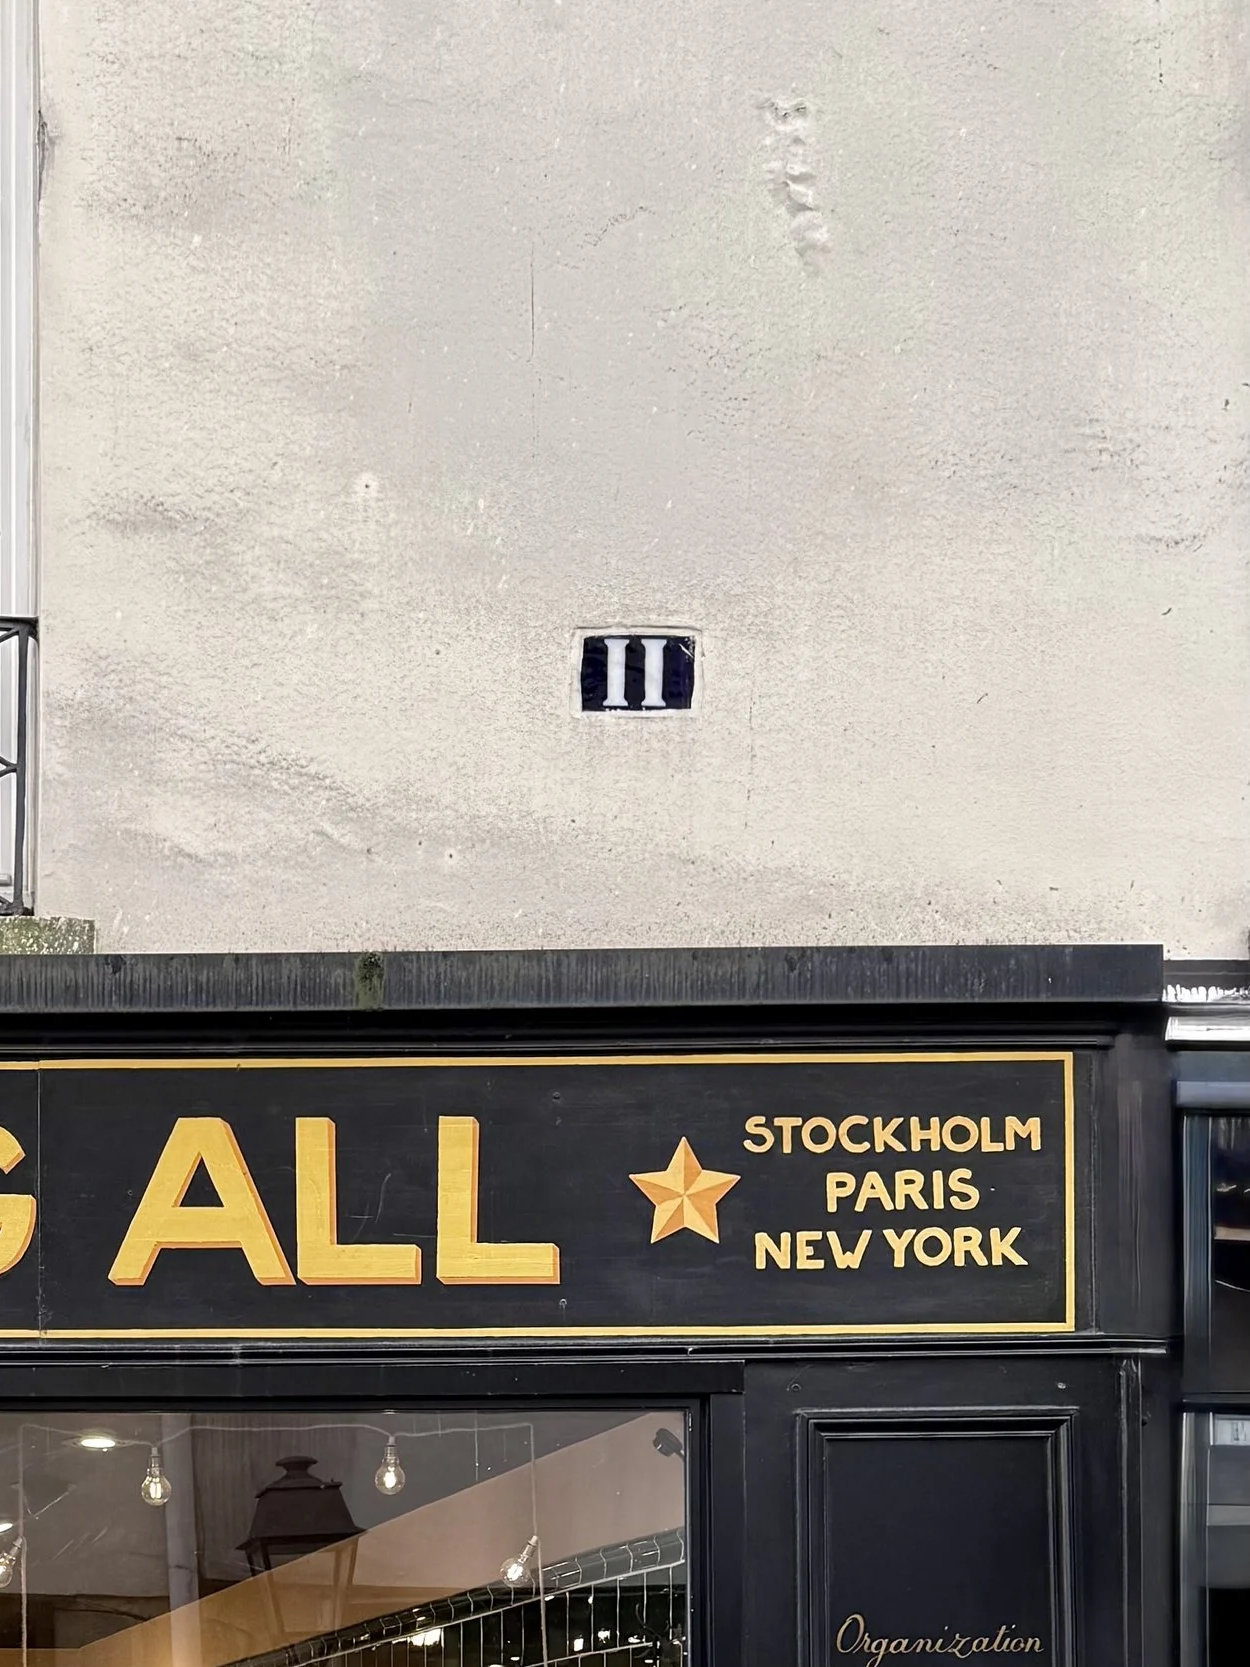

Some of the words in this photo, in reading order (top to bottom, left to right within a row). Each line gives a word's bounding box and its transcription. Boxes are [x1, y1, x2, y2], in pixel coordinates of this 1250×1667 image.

[602, 638, 667, 706] 11
[742, 1114, 1042, 1155] STOCKHOLM
[107, 1115, 561, 1286] ALL
[826, 1168, 980, 1213] PARIS
[754, 1229, 872, 1270] NEW
[882, 1226, 1029, 1268] YORK
